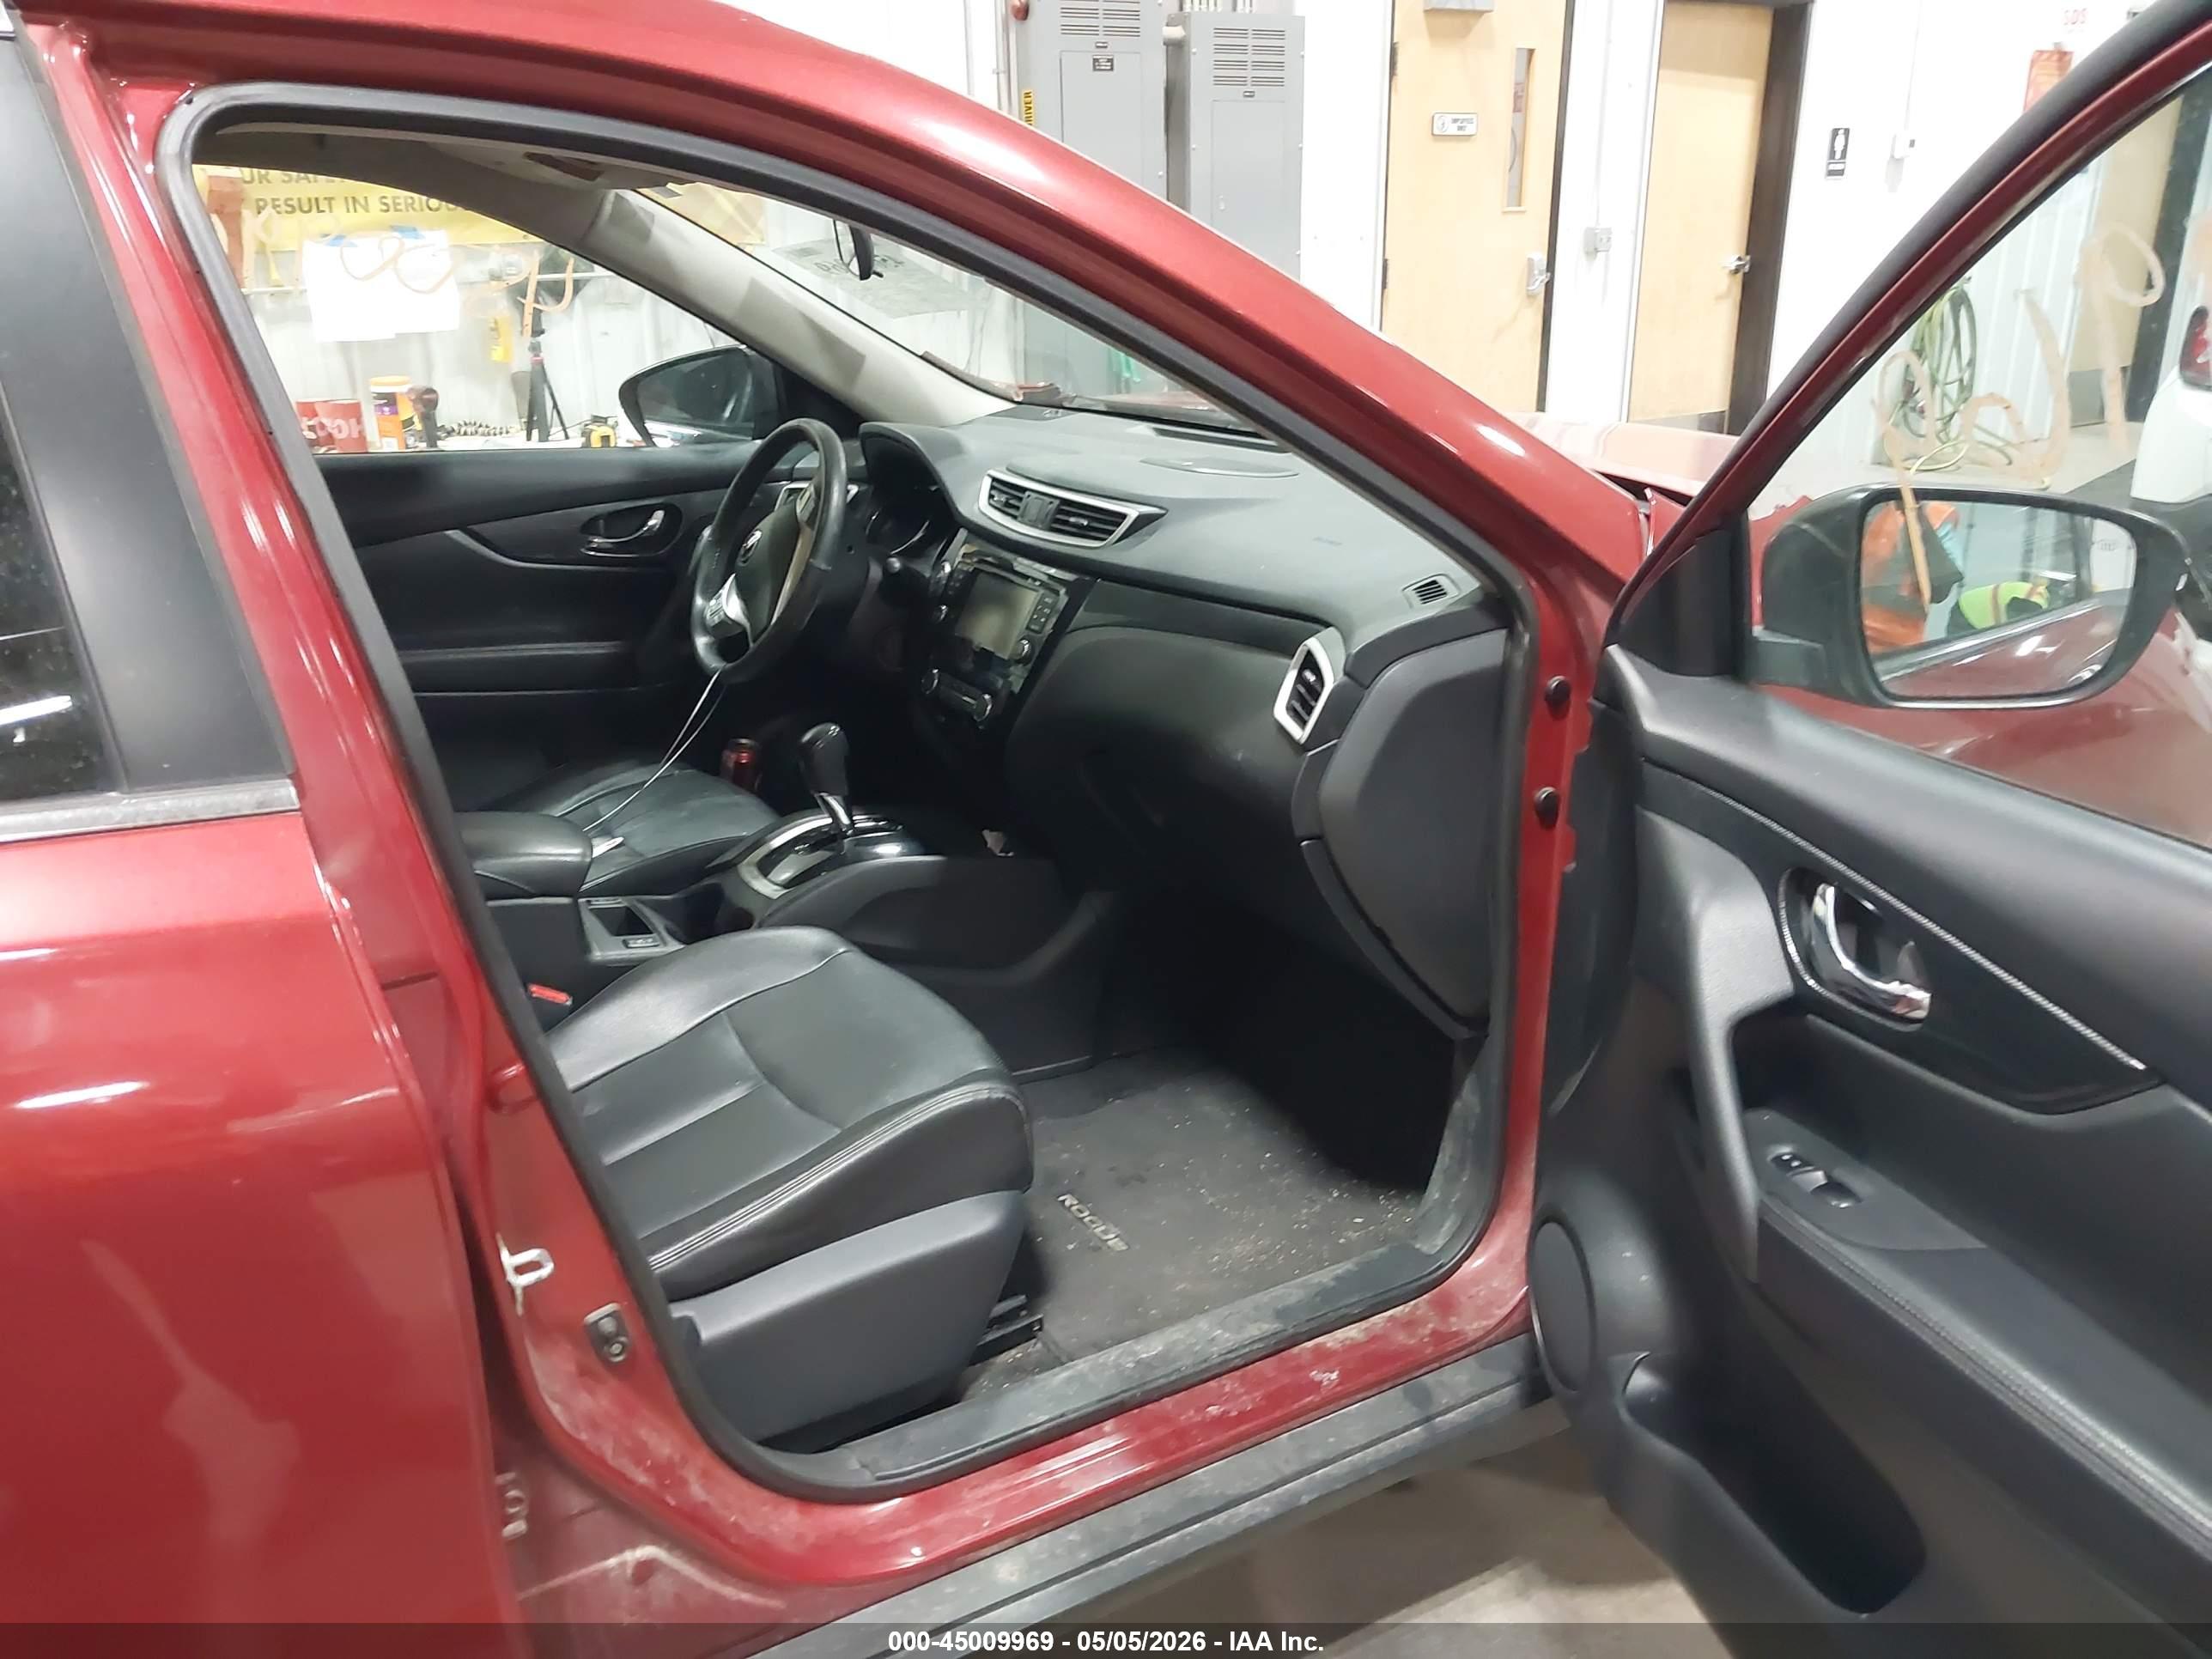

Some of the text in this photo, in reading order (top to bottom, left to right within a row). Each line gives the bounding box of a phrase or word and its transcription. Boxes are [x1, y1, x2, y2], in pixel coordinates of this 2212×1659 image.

[256, 197, 337, 214] RESULT
[345, 197, 369, 213] IN
[1057, 1194, 1129, 1251] ROGUE
